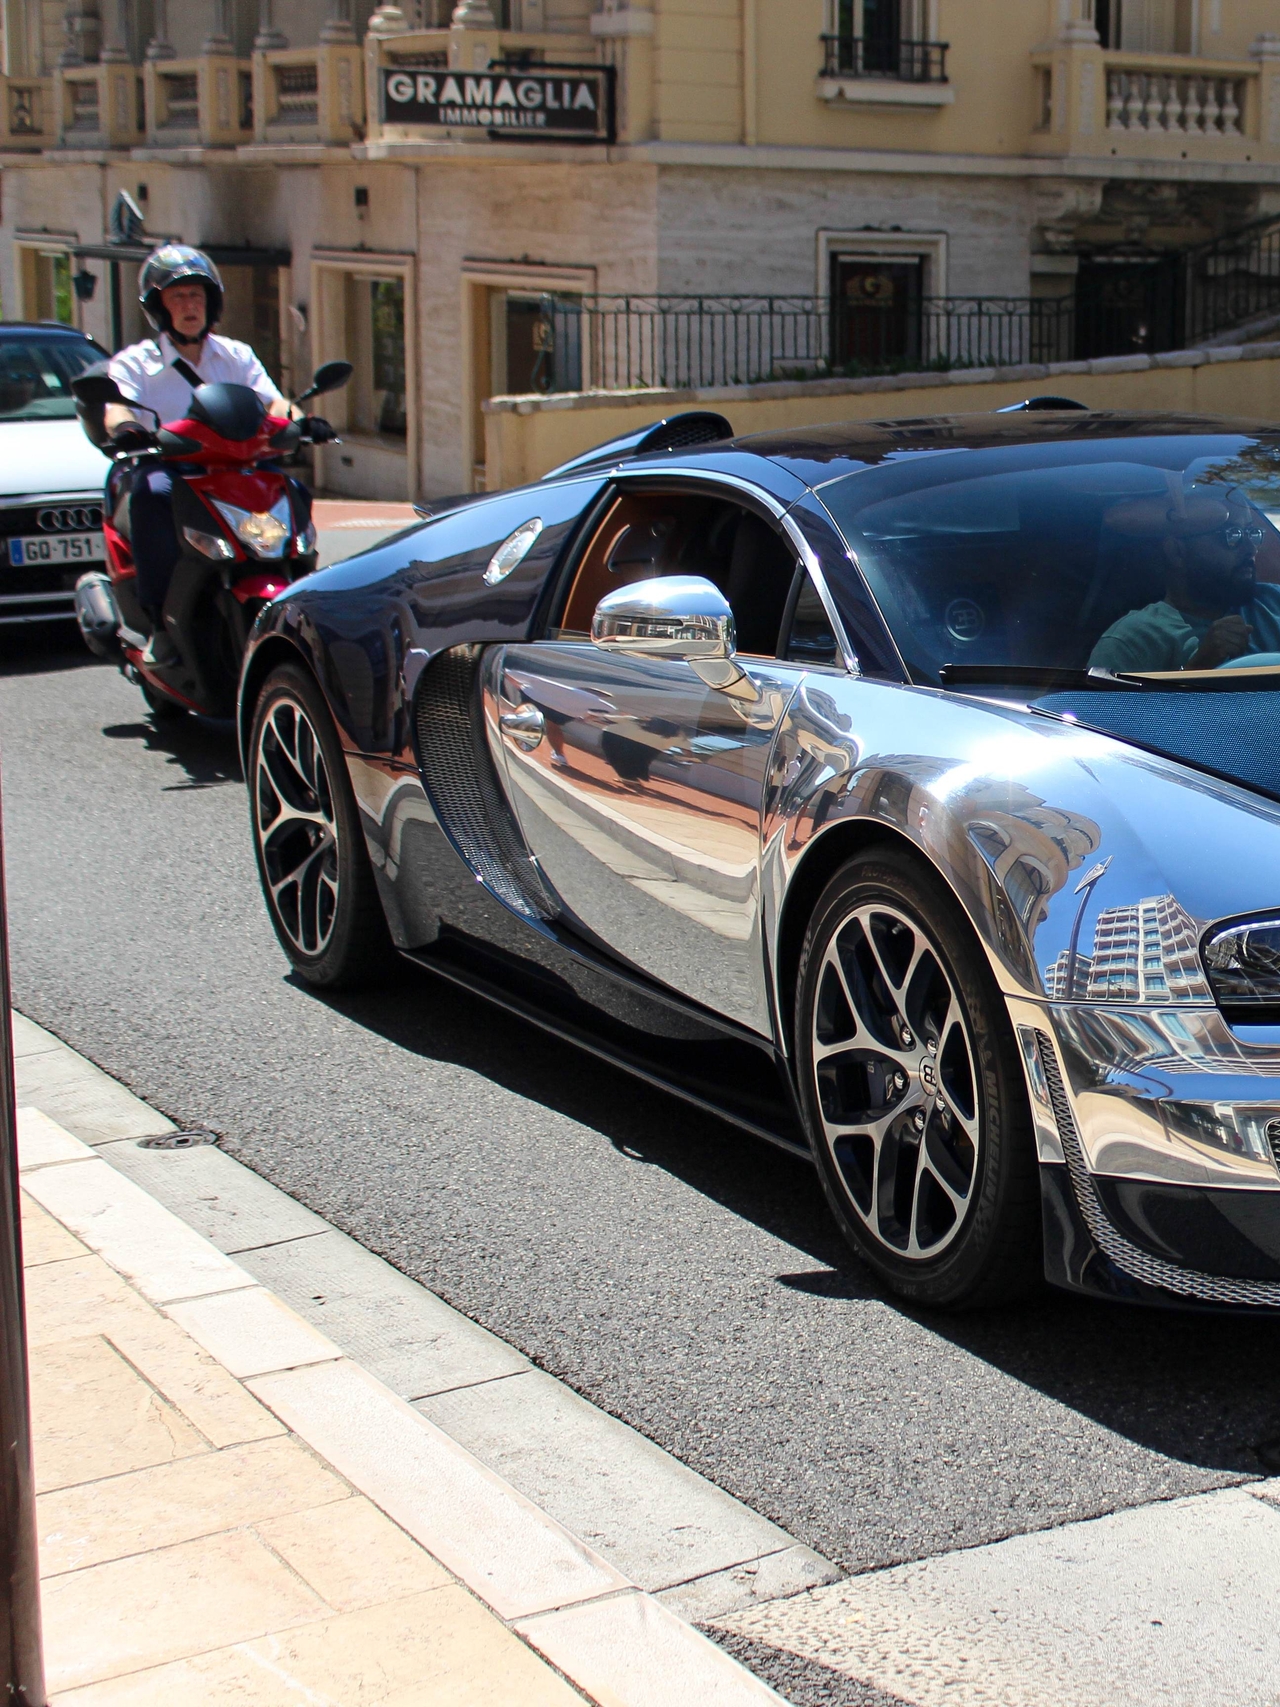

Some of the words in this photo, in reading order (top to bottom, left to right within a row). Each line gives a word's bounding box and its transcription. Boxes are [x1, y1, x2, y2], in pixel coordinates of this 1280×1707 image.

[387, 73, 596, 111] GRAMAGLIA
[439, 107, 547, 127] IMMOBILIER
[985, 1070, 1001, 1202] MICHELIN
